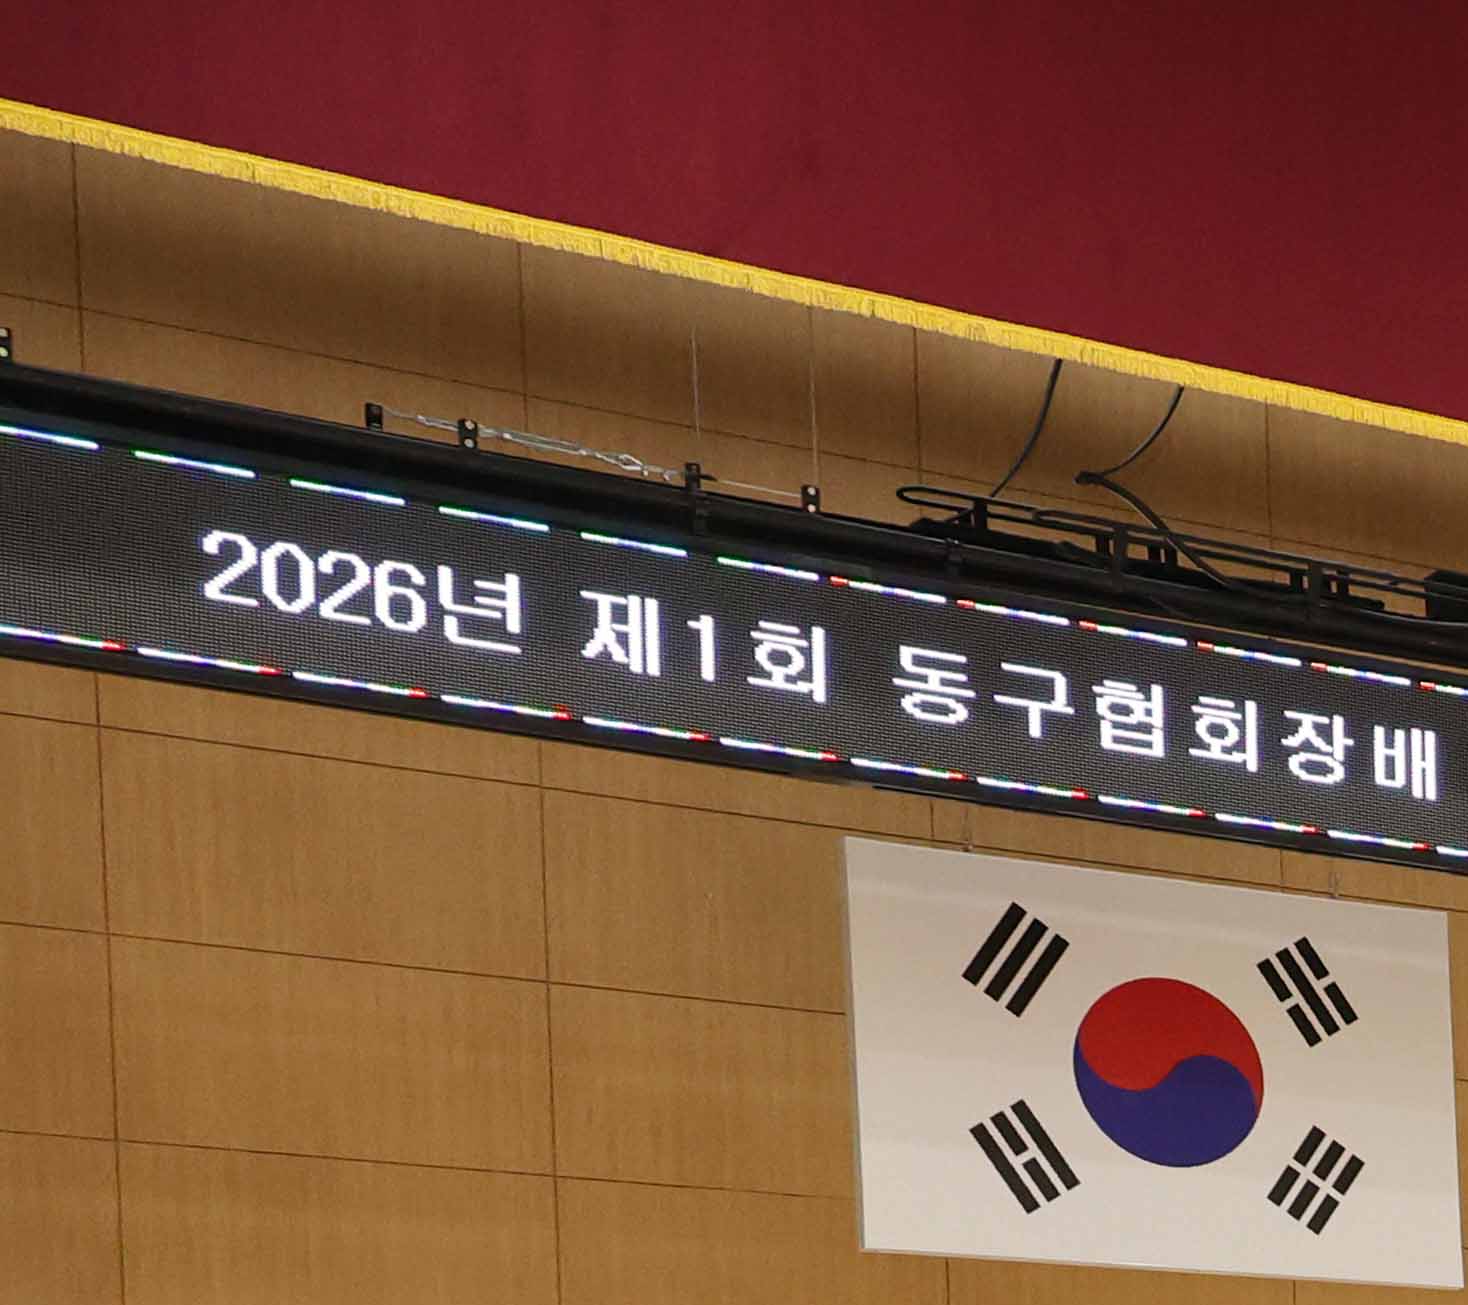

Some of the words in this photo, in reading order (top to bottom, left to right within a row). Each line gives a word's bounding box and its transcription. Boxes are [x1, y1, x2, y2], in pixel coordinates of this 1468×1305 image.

[203, 531, 523, 656] 2026년
[579, 586, 828, 704] 제1회
[891, 644, 1440, 802] 동구협회장배
